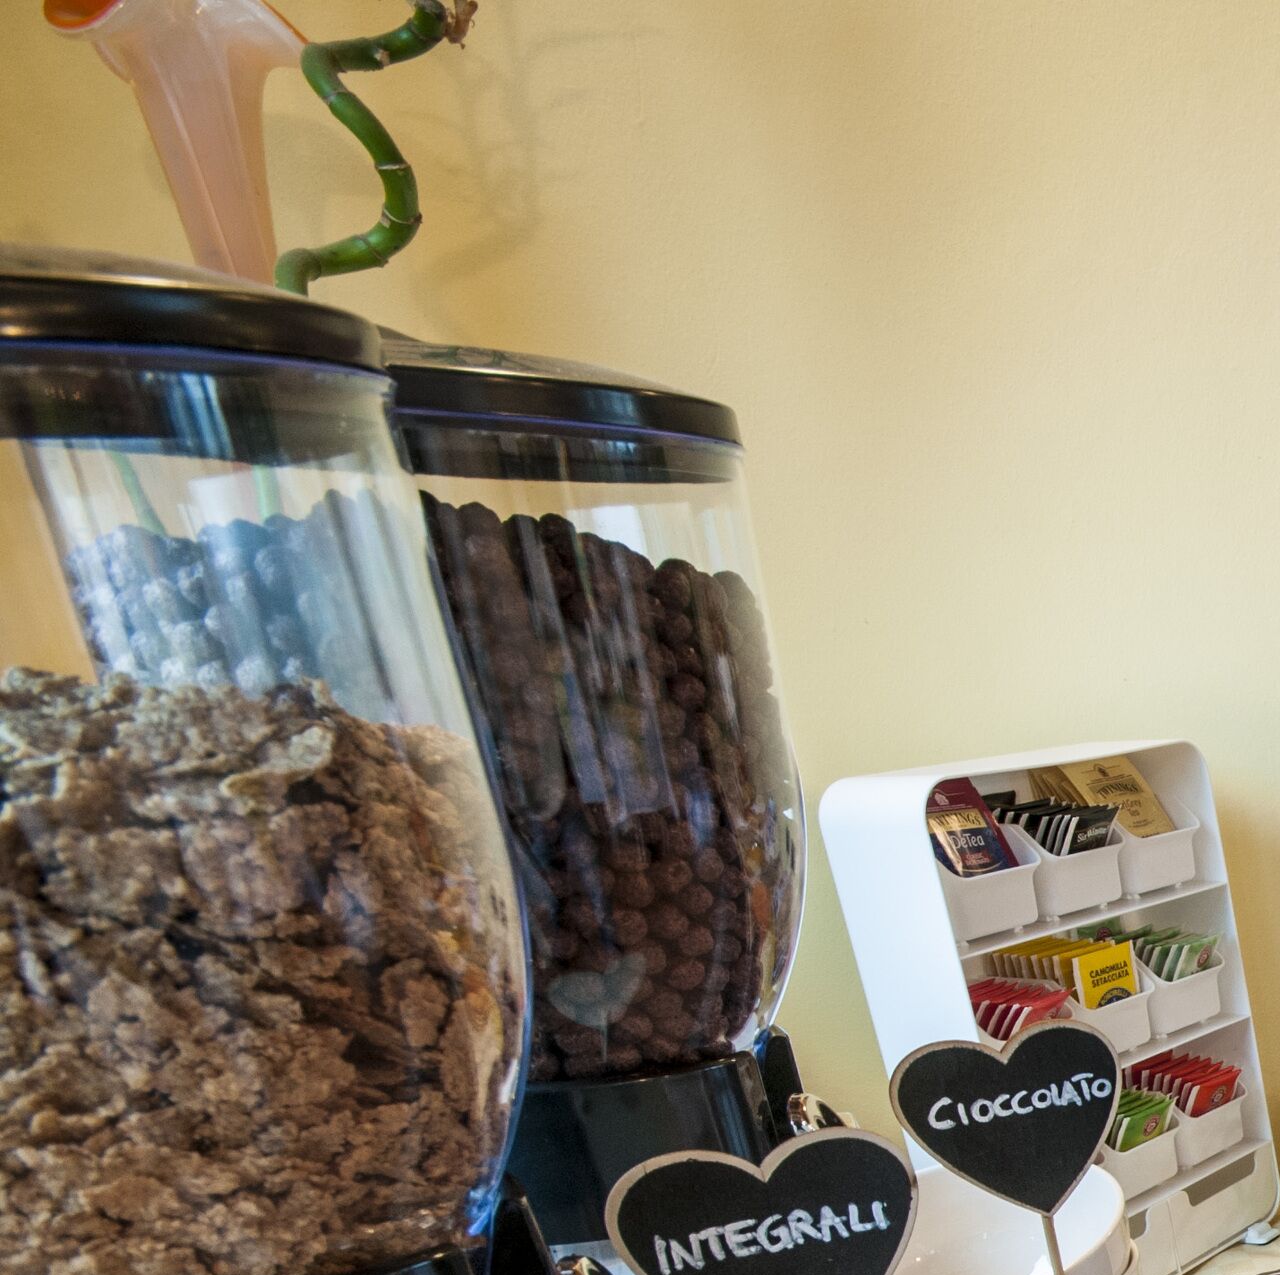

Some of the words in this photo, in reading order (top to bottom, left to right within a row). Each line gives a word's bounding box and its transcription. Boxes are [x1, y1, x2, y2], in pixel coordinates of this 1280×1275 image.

[950, 833, 986, 849] DeTea
[1089, 959, 1128, 980] CAMOMILLA
[1091, 969, 1130, 989] SETACCIATA
